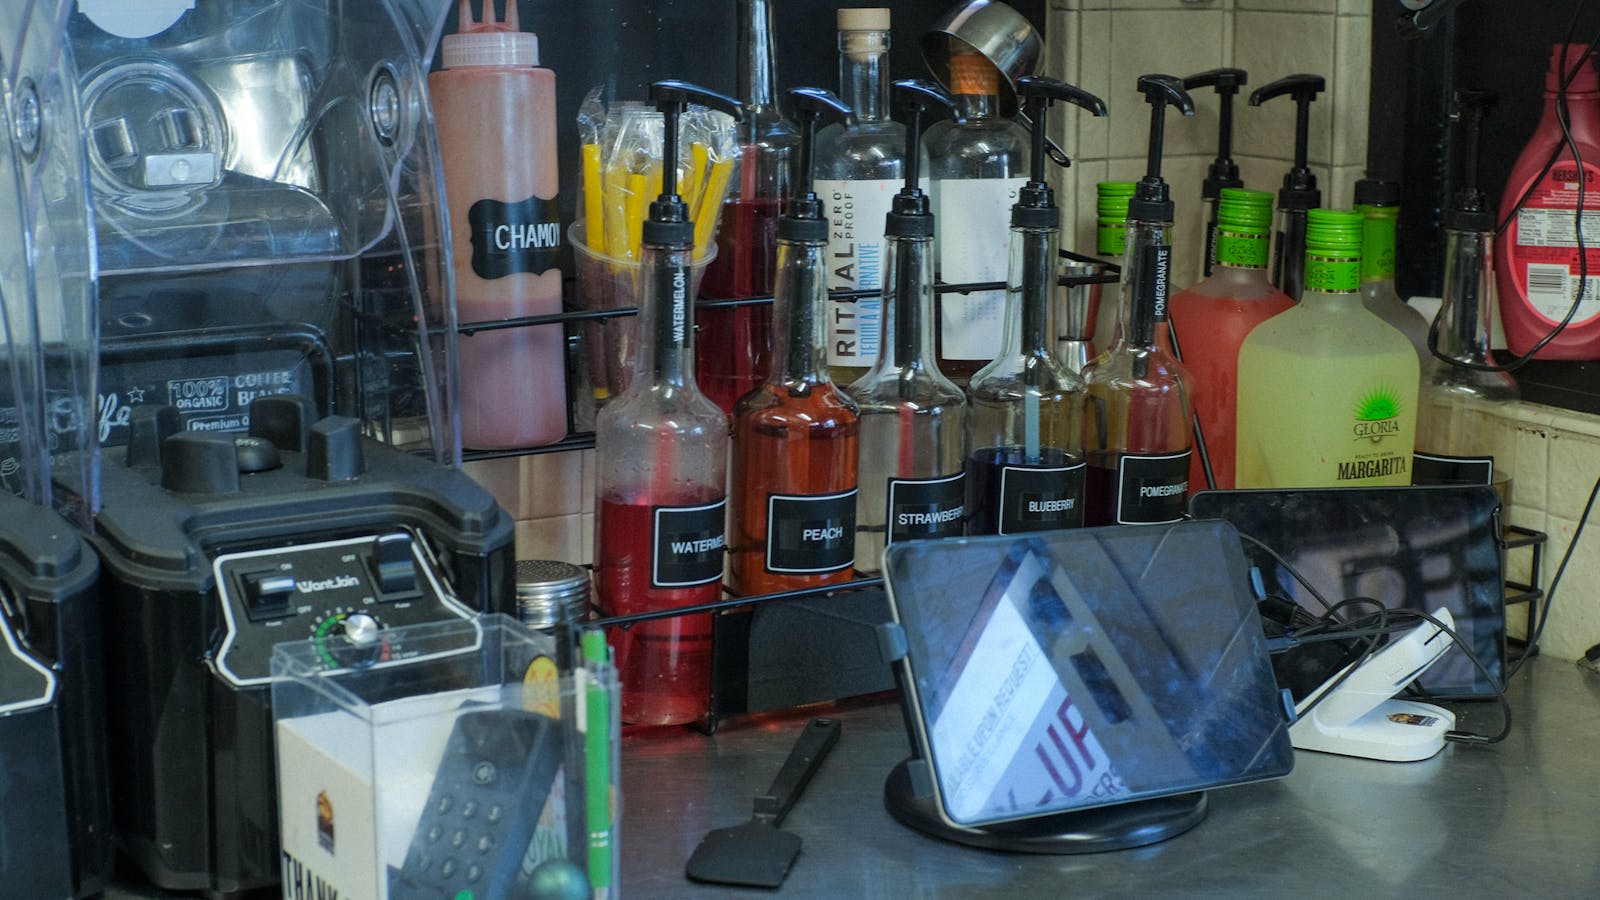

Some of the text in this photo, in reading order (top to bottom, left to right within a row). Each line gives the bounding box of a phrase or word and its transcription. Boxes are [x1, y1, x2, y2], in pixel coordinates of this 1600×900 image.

[833, 191, 843, 239] ZERO
[844, 192, 854, 239] PROOF
[859, 242, 880, 310] ALRNATIVE
[1155, 250, 1168, 317] POMEGRANATE
[672, 271, 686, 343] WATERMELON
[172, 379, 226, 398] 100%
[176, 396, 223, 409] ORGANIC
[1353, 420, 1400, 437] GLORIA
[1336, 456, 1406, 480] MARGARITA
[1028, 498, 1075, 513] BLUEBERRY
[802, 526, 843, 542] PEACH
